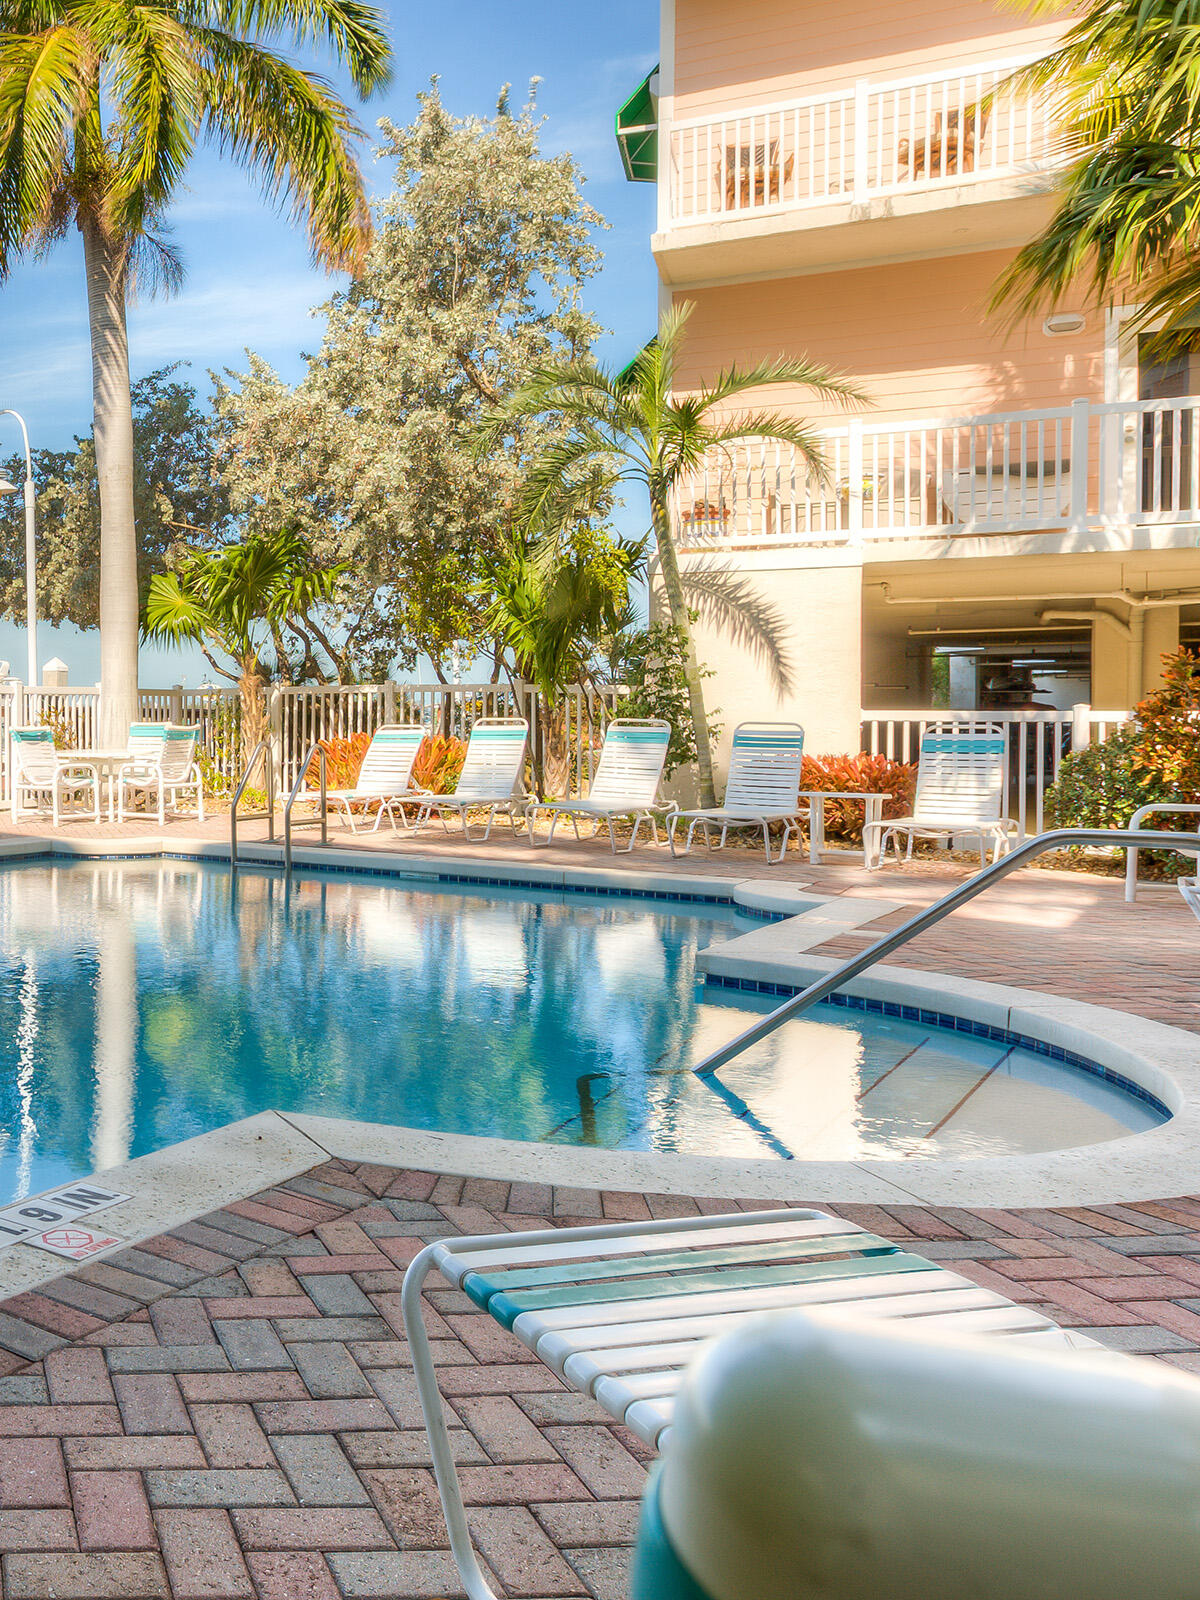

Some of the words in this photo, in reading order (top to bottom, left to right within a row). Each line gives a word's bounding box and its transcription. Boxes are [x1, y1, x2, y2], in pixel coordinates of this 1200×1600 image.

[18, 1207, 63, 1222] 9
[51, 1187, 121, 1210] IN.
[69, 1250, 89, 1258] NO
[84, 1237, 120, 1253] DIVING
